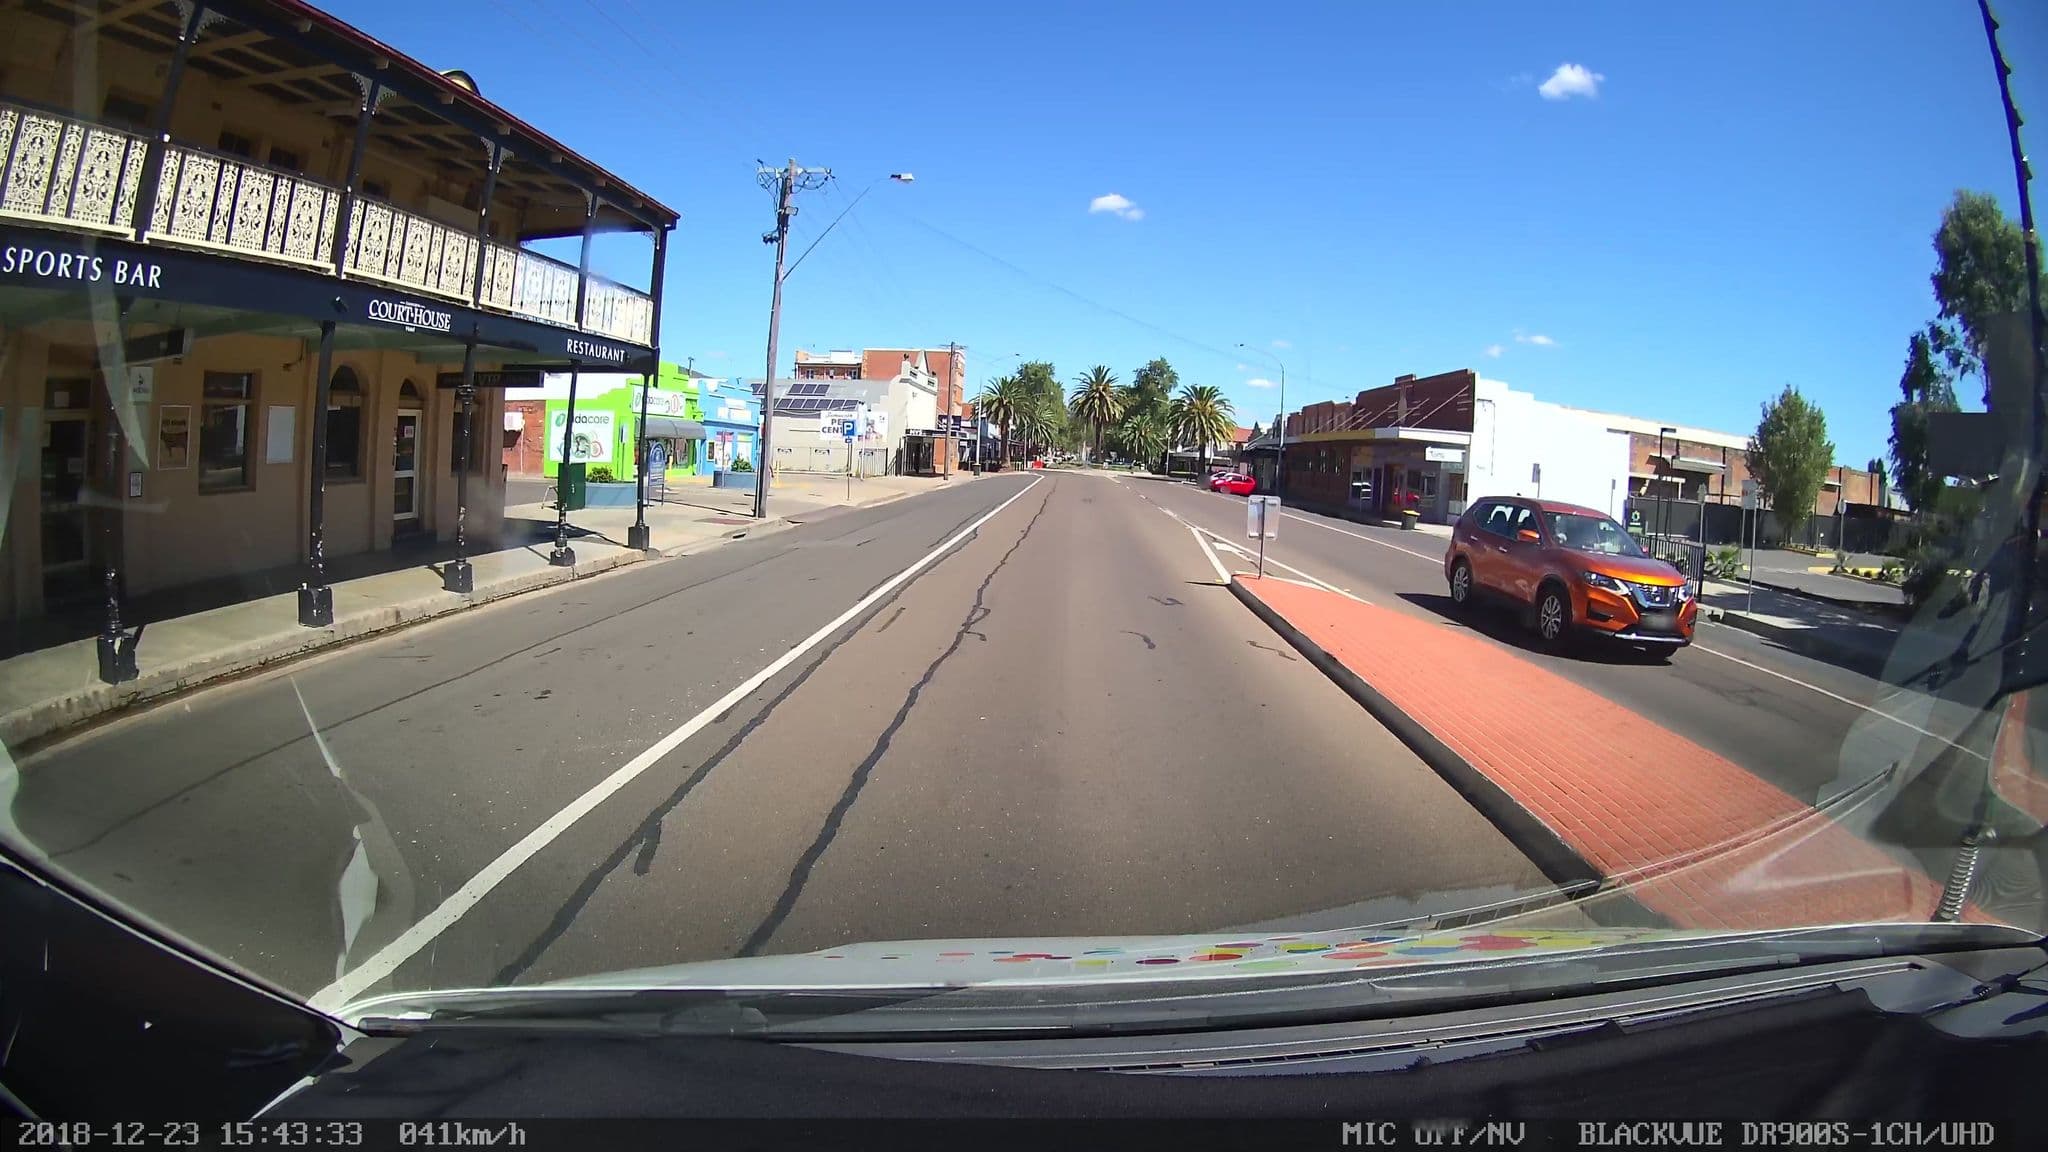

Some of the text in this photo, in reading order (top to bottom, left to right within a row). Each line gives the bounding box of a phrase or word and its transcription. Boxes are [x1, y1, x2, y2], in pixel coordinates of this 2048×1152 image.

[3, 246, 161, 288] SPORTS BAR
[566, 338, 625, 363] RESTAURANT
